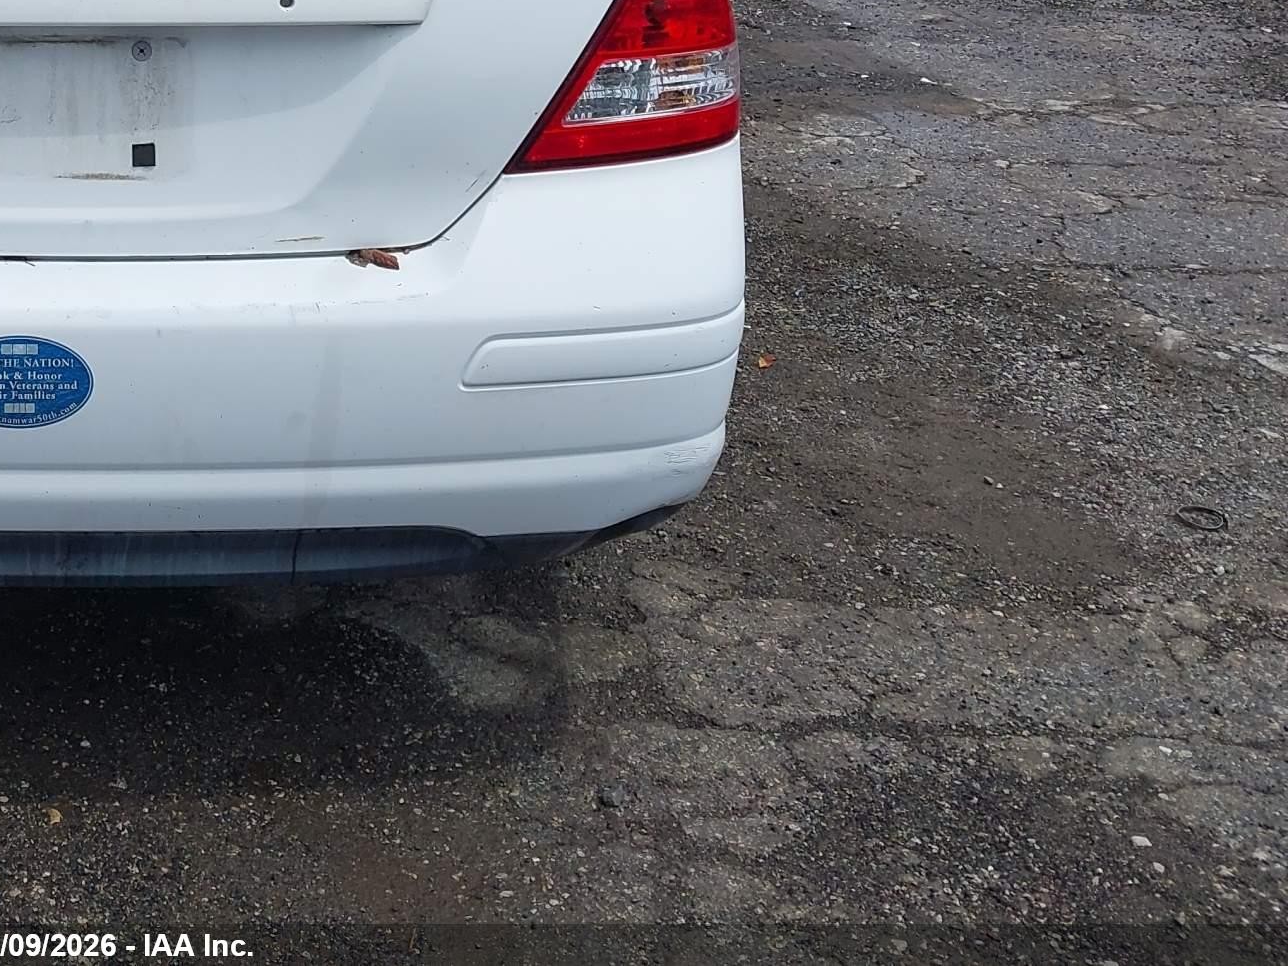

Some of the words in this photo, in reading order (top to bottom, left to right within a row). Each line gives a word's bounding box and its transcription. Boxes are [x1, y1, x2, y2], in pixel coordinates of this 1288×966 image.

[23, 358, 74, 368] NATION!
[13, 372, 24, 380] &
[27, 371, 63, 380] Honor
[9, 380, 55, 390] Veterans
[57, 380, 78, 390] and
[12, 390, 56, 400] Families
